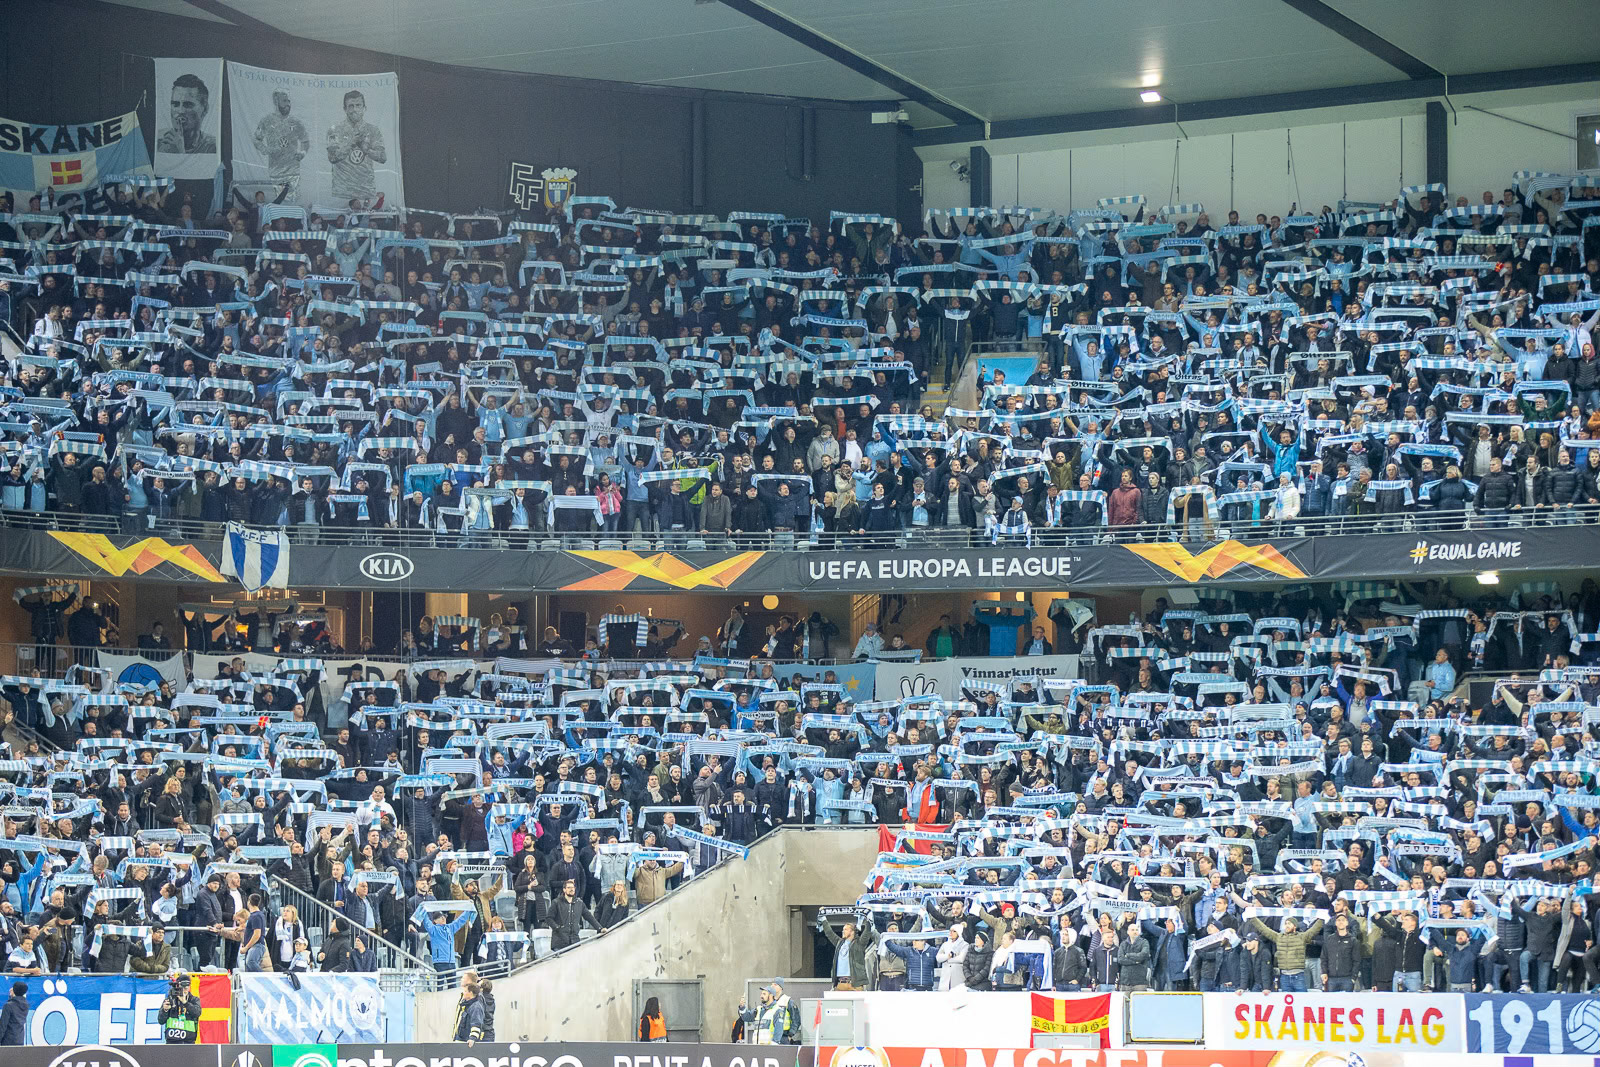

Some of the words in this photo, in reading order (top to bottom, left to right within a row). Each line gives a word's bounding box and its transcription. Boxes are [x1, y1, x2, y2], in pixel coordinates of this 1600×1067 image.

[308, 79, 325, 89] FÖR
[1070, 380, 1104, 389] Øltras
[369, 559, 405, 575] KIA
[809, 561, 872, 580] UEFA
[878, 558, 971, 579] EUROPA
[961, 666, 1057, 679] Vinnarkultur
[1234, 994, 1364, 1043] SKÅNES
[1376, 1006, 1445, 1046] LAG
[168, 1029, 187, 1039] 020
